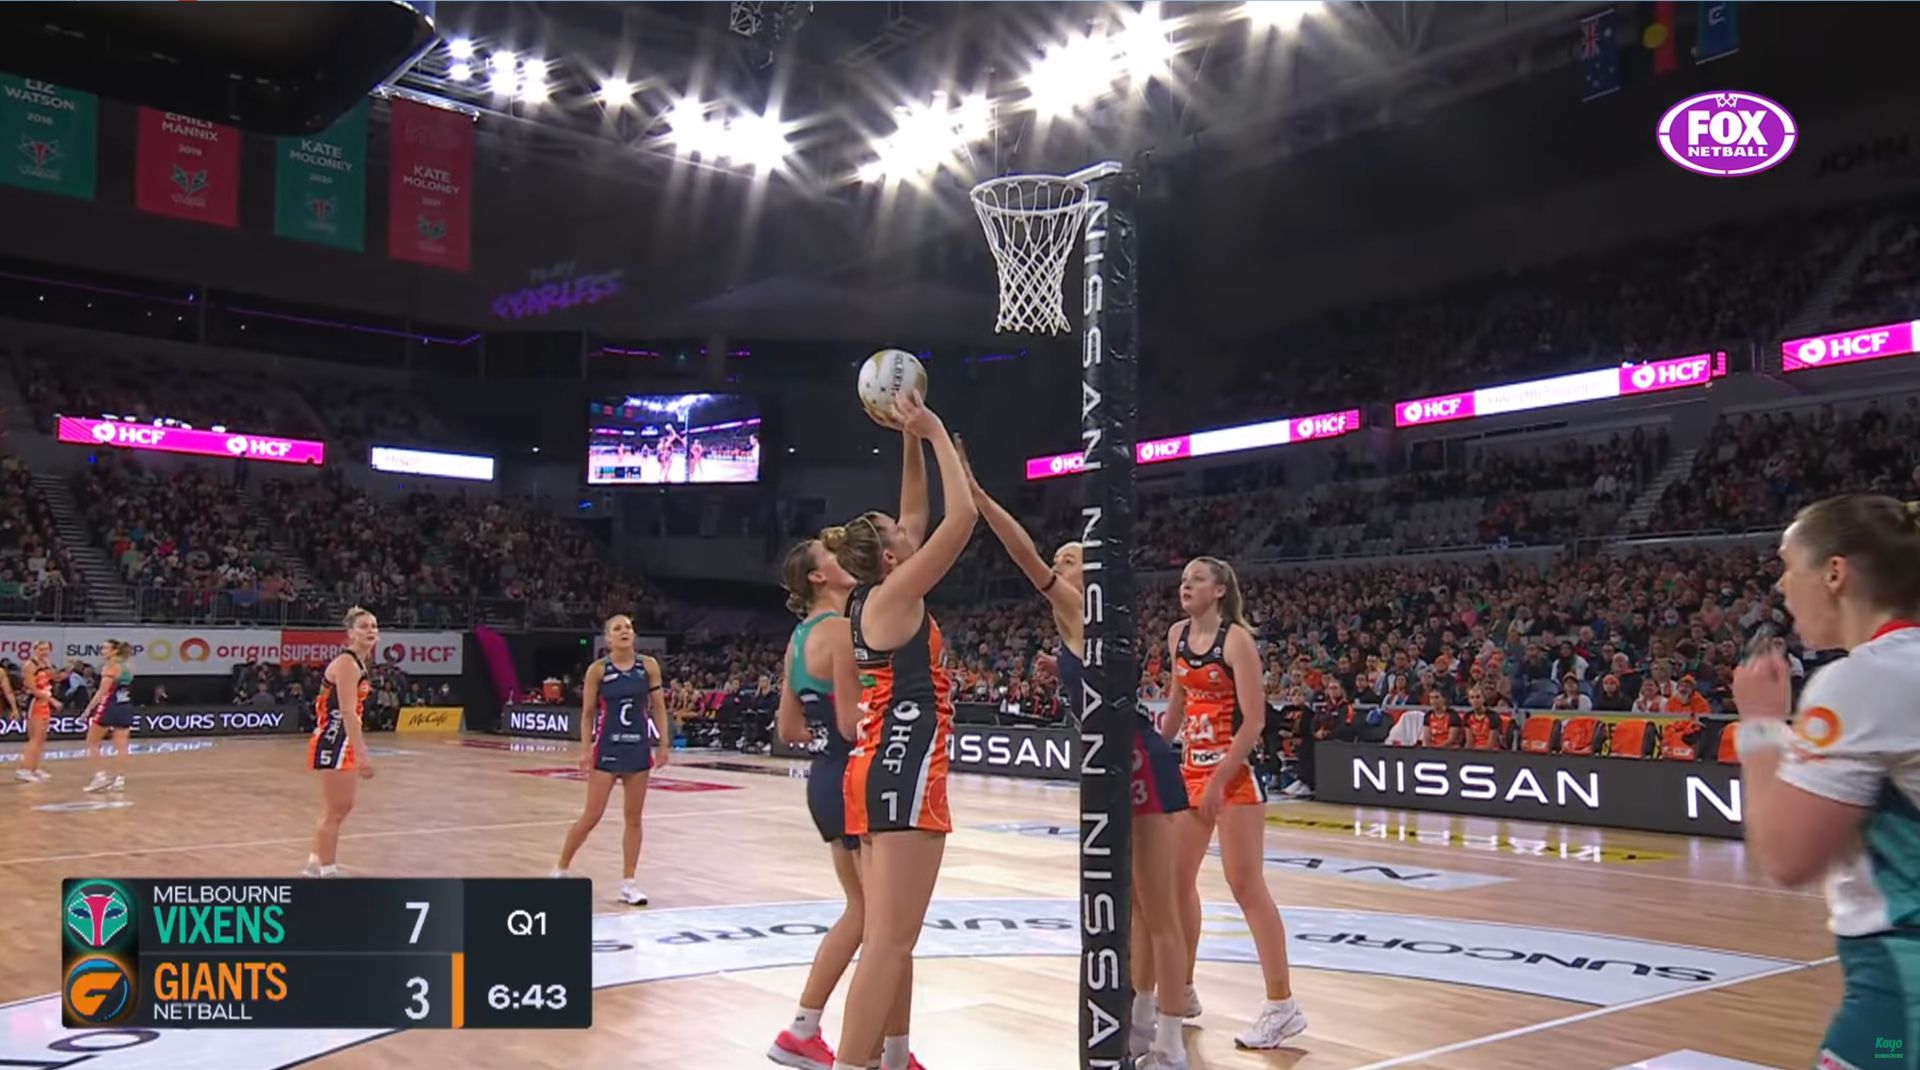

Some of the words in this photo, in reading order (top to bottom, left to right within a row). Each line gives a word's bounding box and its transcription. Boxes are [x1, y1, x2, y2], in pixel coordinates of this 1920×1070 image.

[5, 85, 76, 111] WATSON
[161, 121, 218, 142] MANNIX
[301, 139, 343, 159] KATE
[289, 150, 353, 172] MOLONEY
[403, 174, 460, 195] MOLONEY
[413, 164, 451, 183] KATE
[1082, 201, 1108, 470] NISSAN
[1831, 331, 1889, 358] HCF
[1658, 359, 1707, 384] HCF
[1424, 398, 1462, 417] HCF
[1314, 415, 1347, 434] HCF
[118, 427, 166, 445] HCF
[250, 439, 293, 457] HCF
[1155, 440, 1181, 456] HCF
[1081, 507, 1106, 774] NISSAN
[216, 643, 281, 667] origin
[409, 645, 456, 663] HCF
[146, 714, 215, 731] YOURS
[219, 713, 284, 728] TODAY
[510, 711, 569, 733] NISSAN
[620, 703, 634, 726] C
[320, 750, 333, 765] 5
[883, 725, 912, 773] HCF
[946, 735, 1071, 769] ISSAN
[1353, 757, 1600, 808] NISSAN
[881, 791, 898, 822] 1
[656, 917, 1074, 946] SUNORP
[1082, 813, 1121, 1070] NISSA
[1294, 932, 1718, 983] SUNCORP
